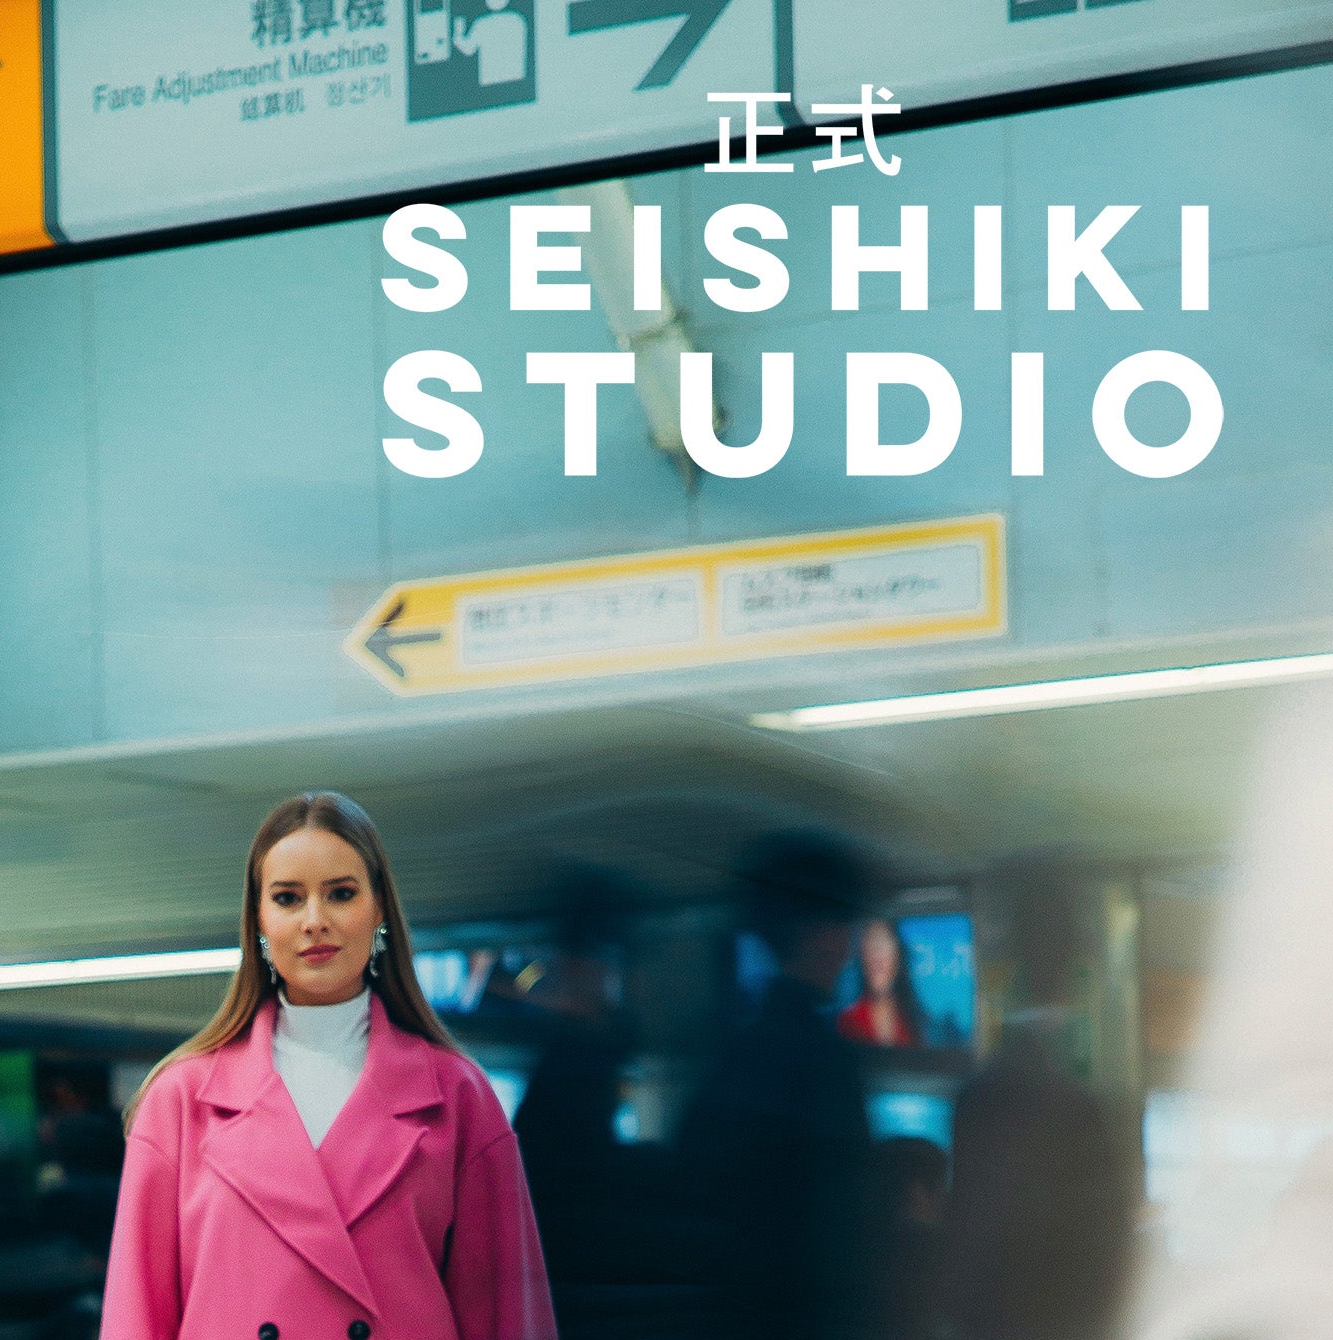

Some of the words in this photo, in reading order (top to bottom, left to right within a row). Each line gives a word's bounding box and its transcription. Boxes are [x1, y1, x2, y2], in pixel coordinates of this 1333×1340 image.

[93, 84, 145, 113] Fare
[152, 56, 282, 106] Adjustment
[288, 40, 389, 78] Machine
